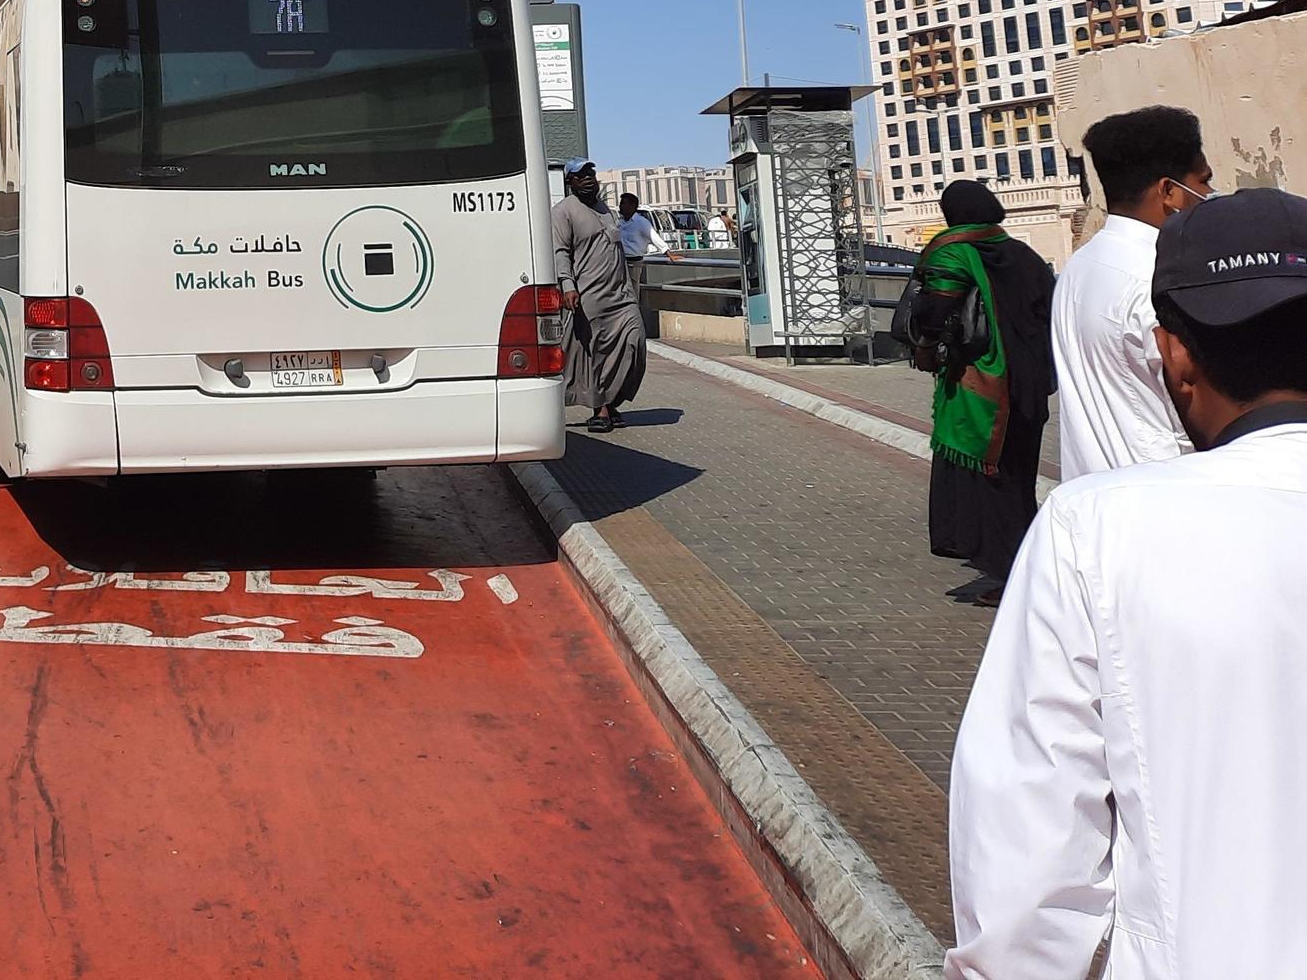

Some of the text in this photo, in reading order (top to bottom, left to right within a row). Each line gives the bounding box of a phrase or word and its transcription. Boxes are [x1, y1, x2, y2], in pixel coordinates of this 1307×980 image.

[269, 163, 327, 176] MAN
[452, 192, 516, 214] MS1173
[173, 234, 302, 255] حافلات مكة
[1207, 252, 1281, 273] TAMANY
[175, 269, 304, 290] Makkah Bus
[276, 371, 305, 386] 4927
